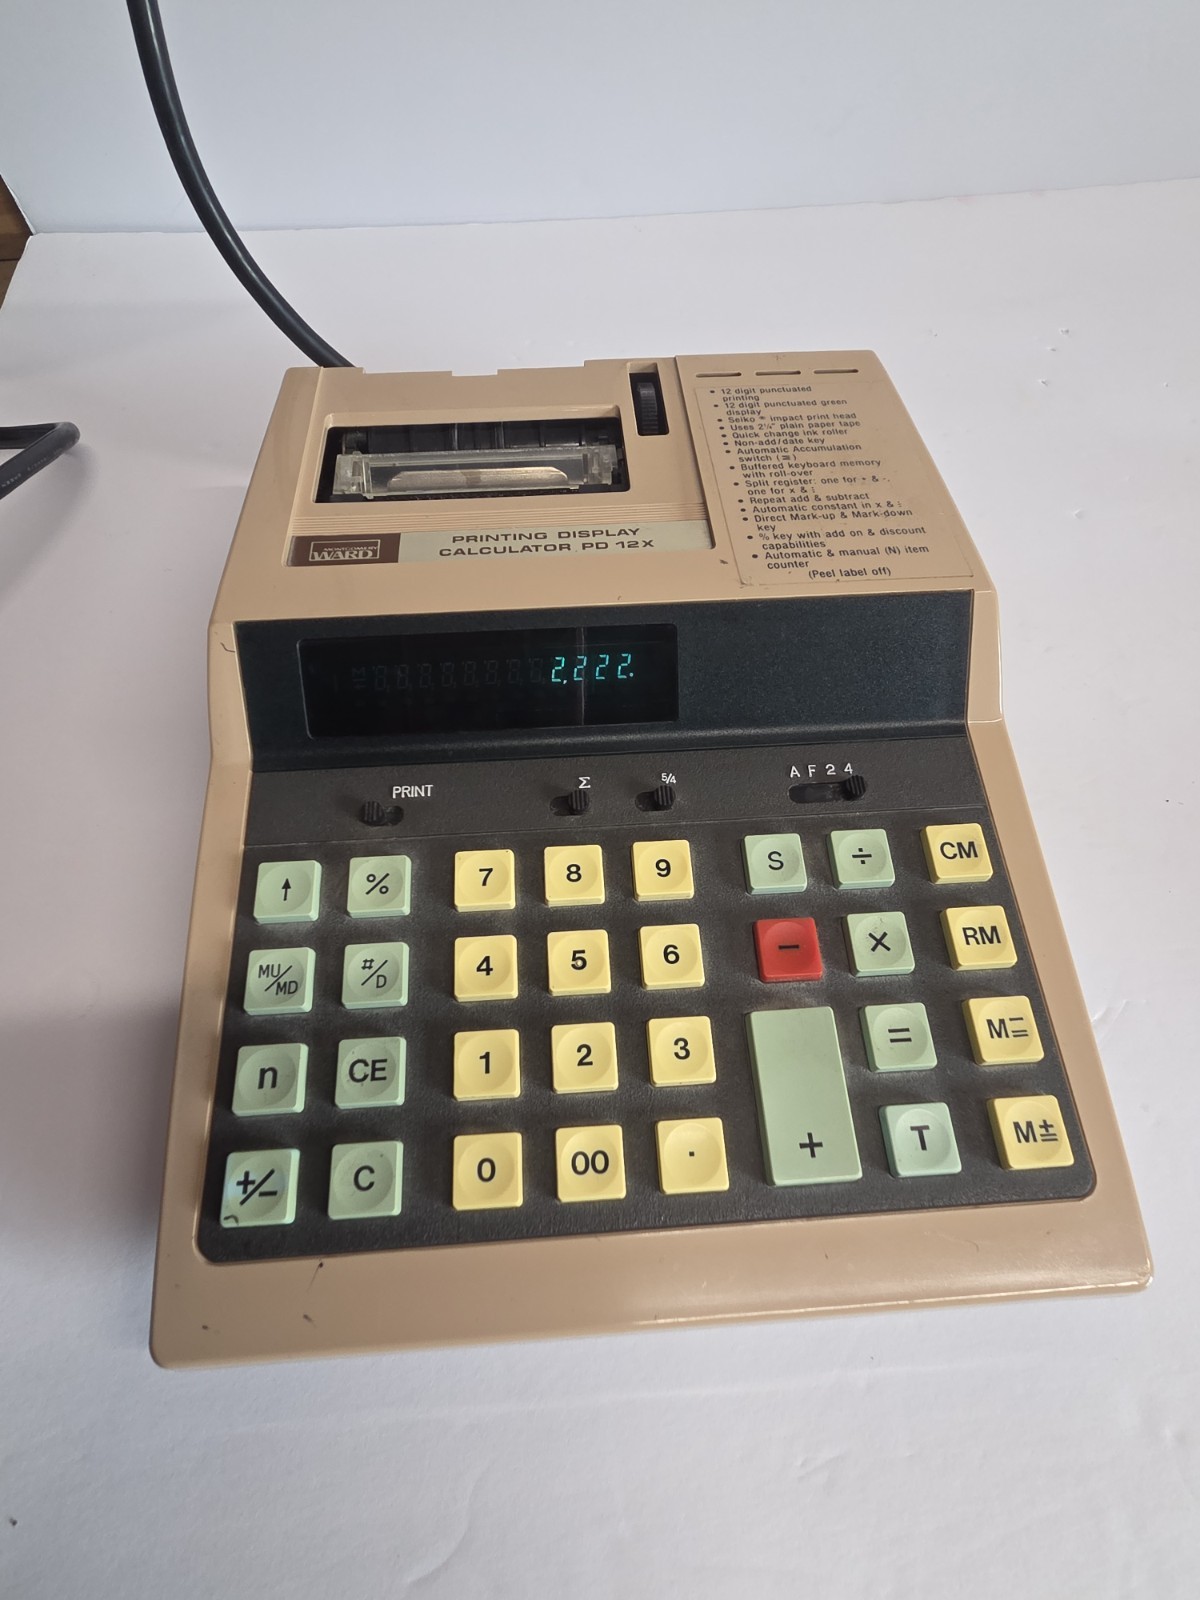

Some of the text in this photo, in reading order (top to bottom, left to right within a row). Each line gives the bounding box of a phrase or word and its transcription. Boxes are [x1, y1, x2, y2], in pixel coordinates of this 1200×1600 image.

[721, 385, 812, 395] 12 digit punctuated
[722, 395, 760, 403] printing
[738, 401, 760, 409] digit
[764, 400, 817, 408] punctuated
[820, 399, 847, 407] green
[769, 414, 803, 422] impact
[806, 413, 830, 421] print
[780, 421, 804, 430] plain
[808, 421, 835, 429] paper
[839, 420, 861, 428] tape
[732, 431, 760, 439] Quick
[764, 430, 800, 438] change
[822, 428, 848, 436] roller
[807, 437, 825, 445] key
[737, 444, 862, 455] Automatic Accumulation
[738, 454, 772, 463] switch
[740, 460, 881, 471] Buffered keyboard memory
[742, 470, 766, 479] with
[745, 479, 770, 488] Split
[821, 477, 839, 485] one
[871, 475, 879, 483] &
[747, 487, 767, 496] one
[770, 486, 785, 494] for
[750, 492, 870, 506] Repeat add & subtract
[752, 503, 808, 513] Automatic
[811, 501, 858, 511] constant
[886, 500, 894, 508] &
[754, 508, 913, 523] Direct Mark-up & Mark-down
[451, 528, 640, 543] PRINTING DISPLAY
[757, 523, 776, 533] key
[758, 526, 927, 541] % key with add on & discount
[439, 543, 571, 557] CALCULATOR
[581, 541, 609, 551] PD
[762, 539, 826, 551] capabilities
[764, 544, 930, 560] Automatic & manual (N) item
[311, 550, 373, 560] WARD
[767, 560, 810, 570] counter
[808, 566, 892, 580] (Peel label off)
[790, 762, 854, 778] A F 2 4
[392, 784, 434, 799] PRINT
[940, 841, 978, 860] CM
[767, 850, 784, 871] S
[566, 863, 582, 883] 8
[654, 859, 672, 878] 9
[365, 872, 390, 896] %
[478, 867, 494, 887] 7
[962, 926, 1001, 945] RM
[570, 950, 587, 971] 5
[662, 944, 680, 965] 6
[476, 955, 494, 976] 4
[576, 1044, 594, 1067] 2
[673, 1037, 691, 1060] 3
[348, 1058, 387, 1083] CE
[479, 1052, 491, 1074] 1
[258, 1065, 278, 1089] n
[909, 1124, 930, 1151] T
[570, 1150, 609, 1174] 00
[476, 1158, 496, 1182] 0
[352, 1165, 375, 1191] C
